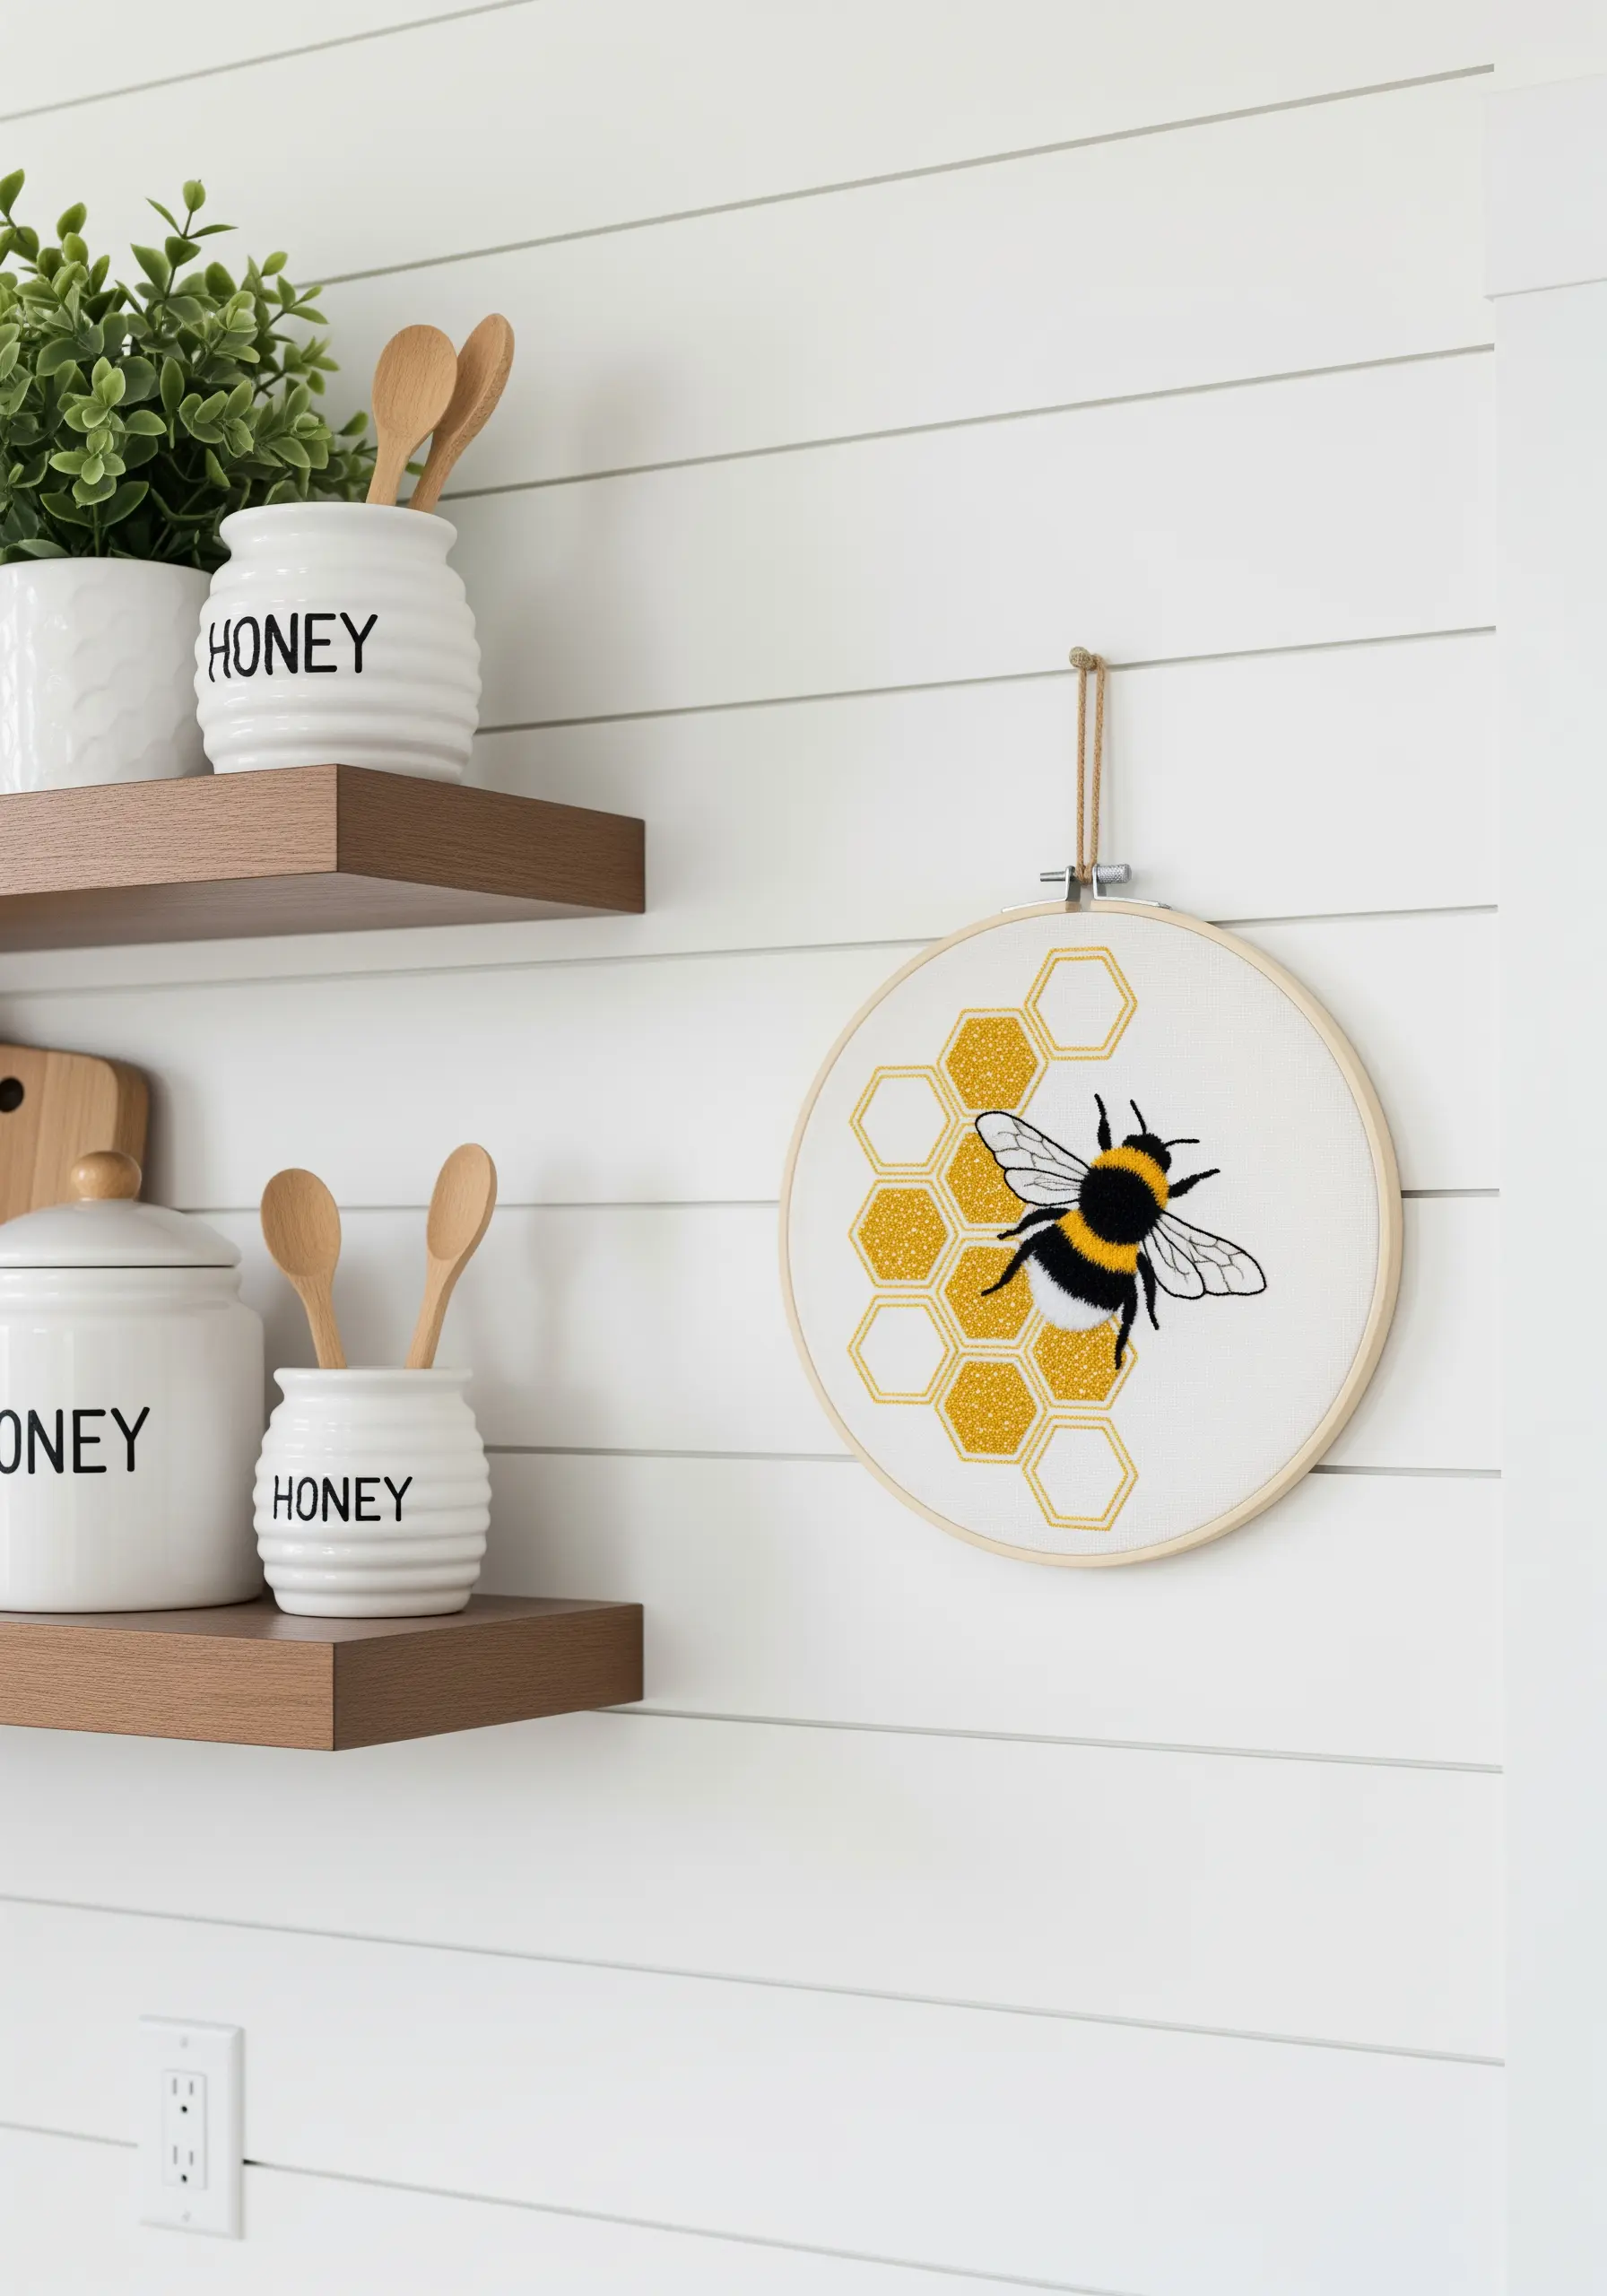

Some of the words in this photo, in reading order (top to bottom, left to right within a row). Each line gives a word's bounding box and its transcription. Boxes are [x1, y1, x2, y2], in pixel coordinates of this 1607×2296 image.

[208, 612, 378, 683] HONEY
[0, 1406, 151, 1474] ONEY
[273, 1474, 413, 1523] HONEY
